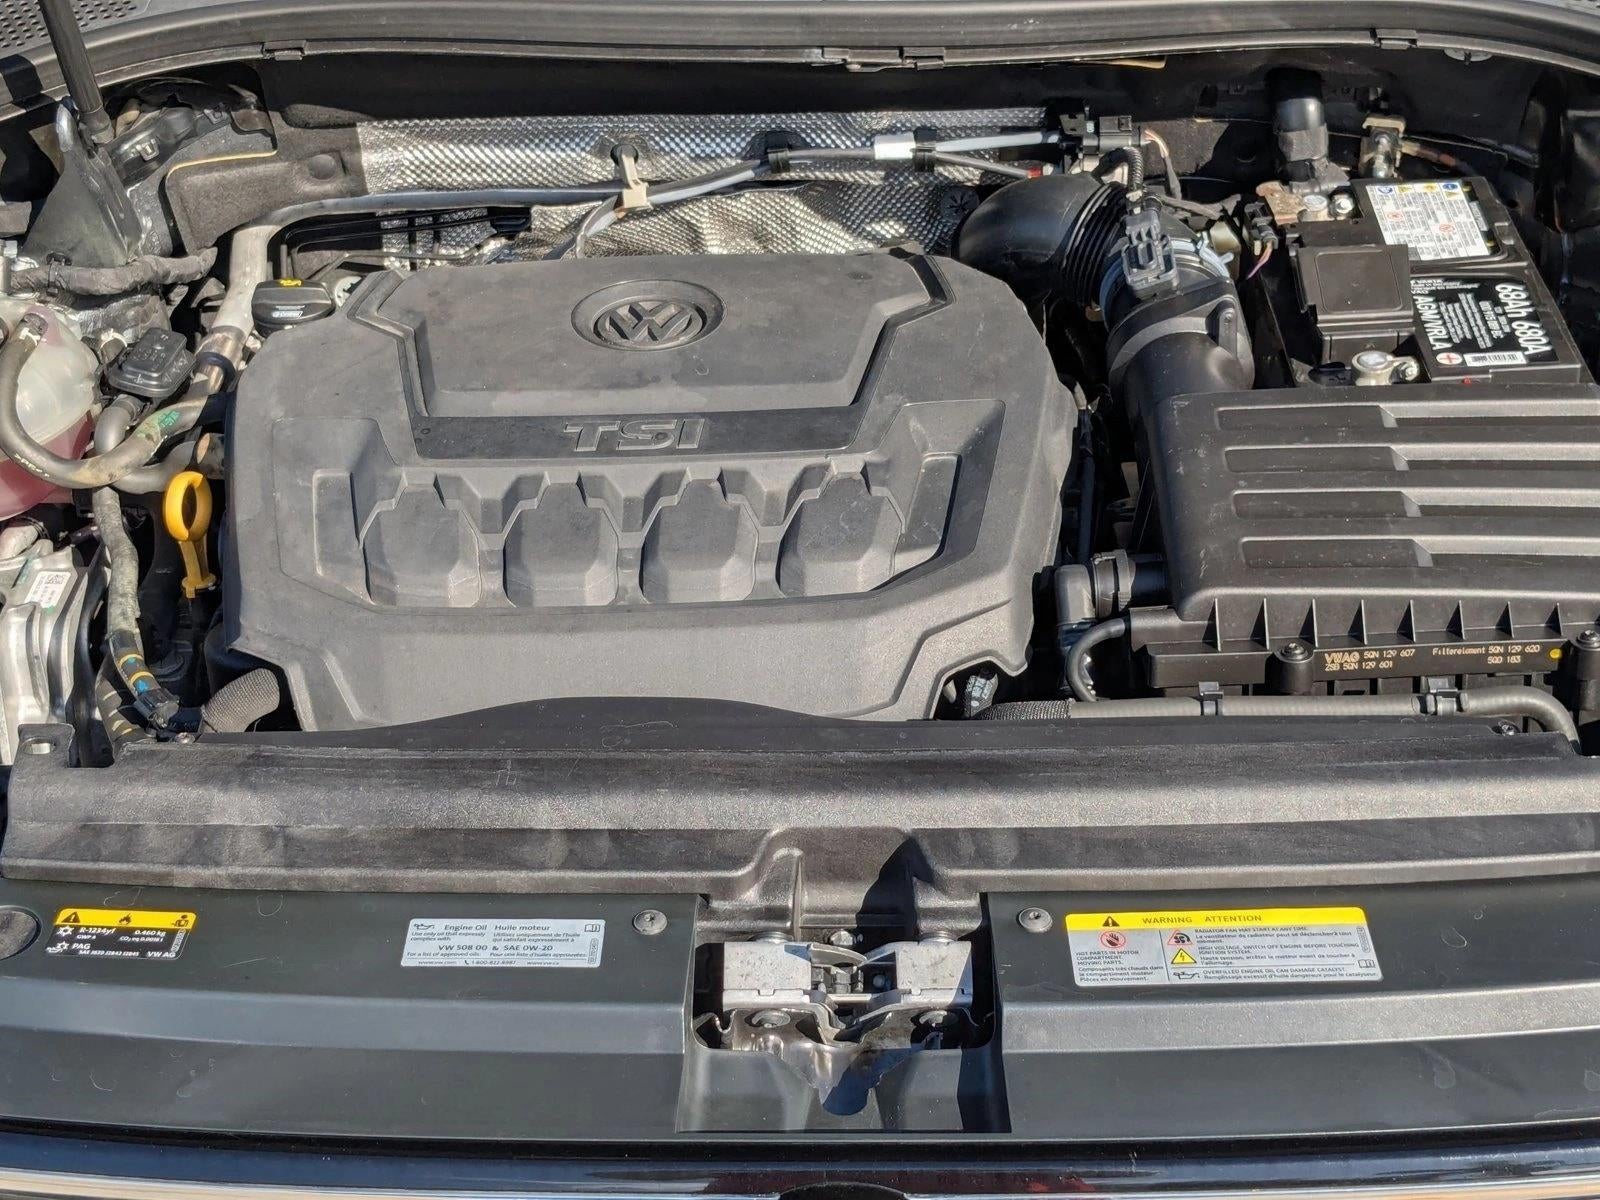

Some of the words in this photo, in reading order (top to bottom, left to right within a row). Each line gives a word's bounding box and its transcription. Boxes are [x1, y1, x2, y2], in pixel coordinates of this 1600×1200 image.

[1495, 282, 1536, 318] 68Ah
[1511, 320, 1552, 355] 680A
[564, 419, 705, 452] TSI
[1383, 650, 1397, 658] 129
[1400, 649, 1416, 657] 607
[80, 927, 116, 936] R-1234yf
